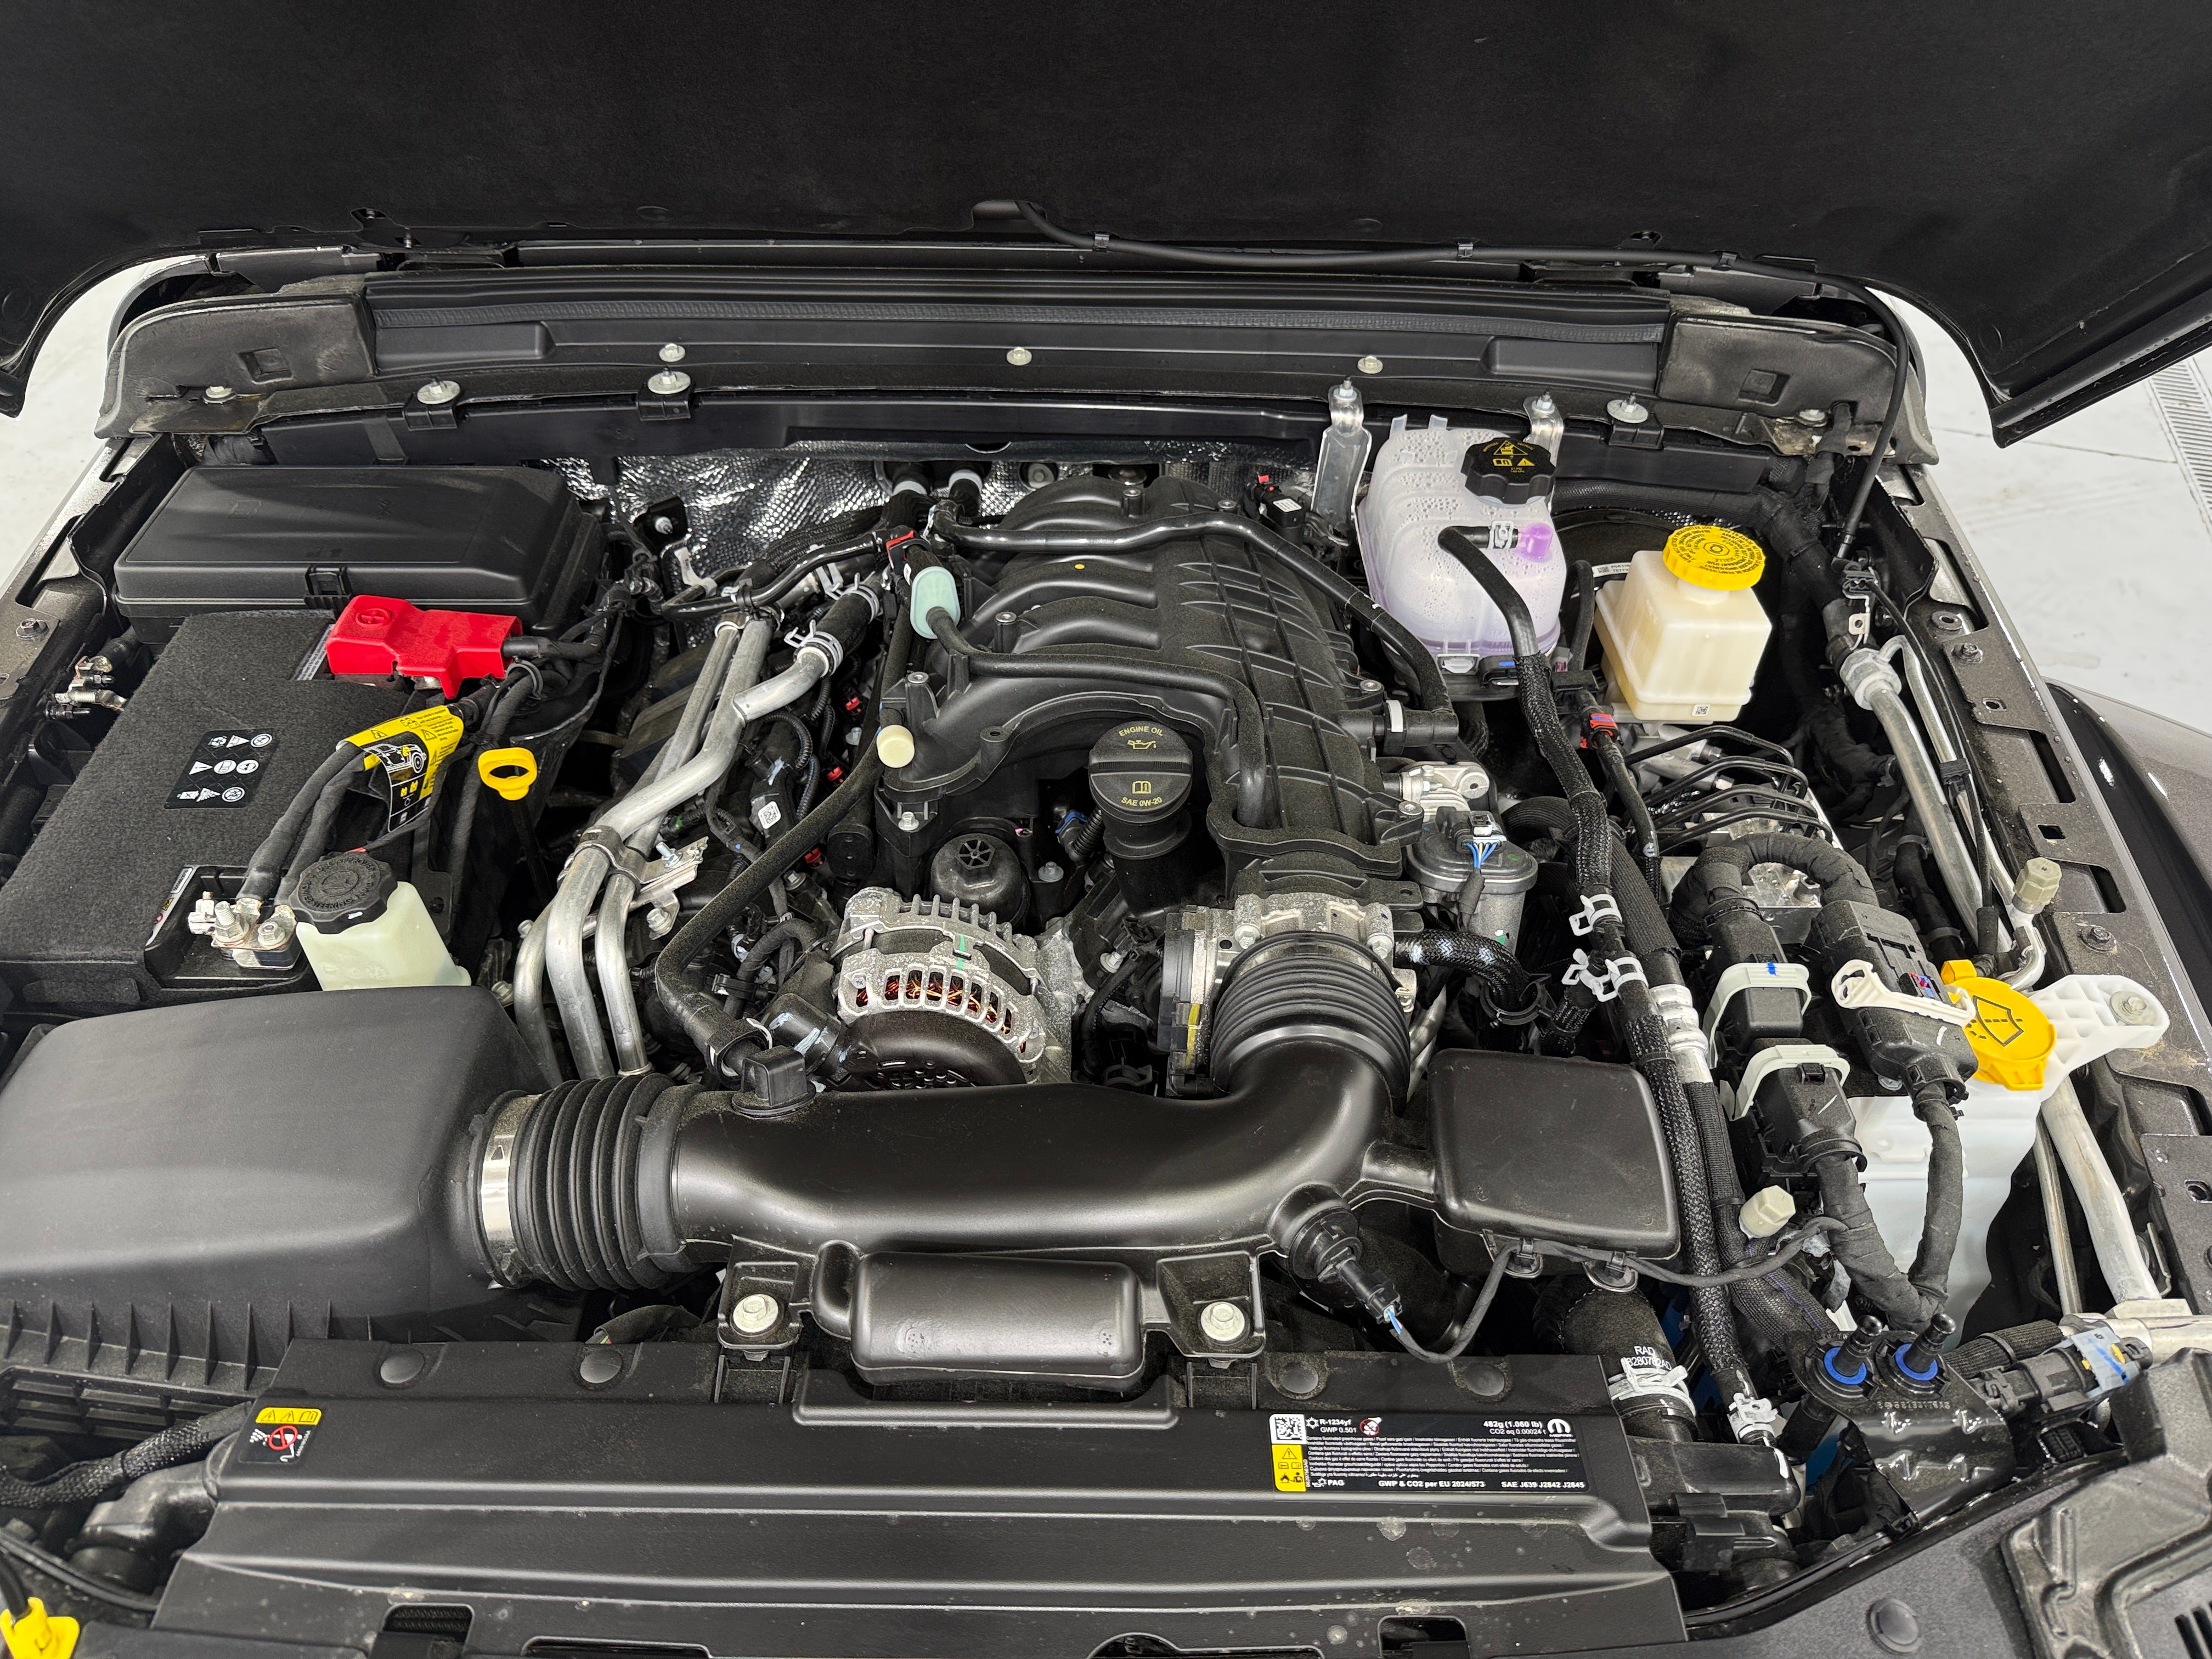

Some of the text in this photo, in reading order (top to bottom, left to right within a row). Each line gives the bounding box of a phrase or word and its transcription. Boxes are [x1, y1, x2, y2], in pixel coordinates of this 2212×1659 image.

[1118, 726, 1164, 737] ENGINE OIL
[1121, 797, 1163, 806] SAE 0W-20
[1634, 1346, 1656, 1357] RAD
